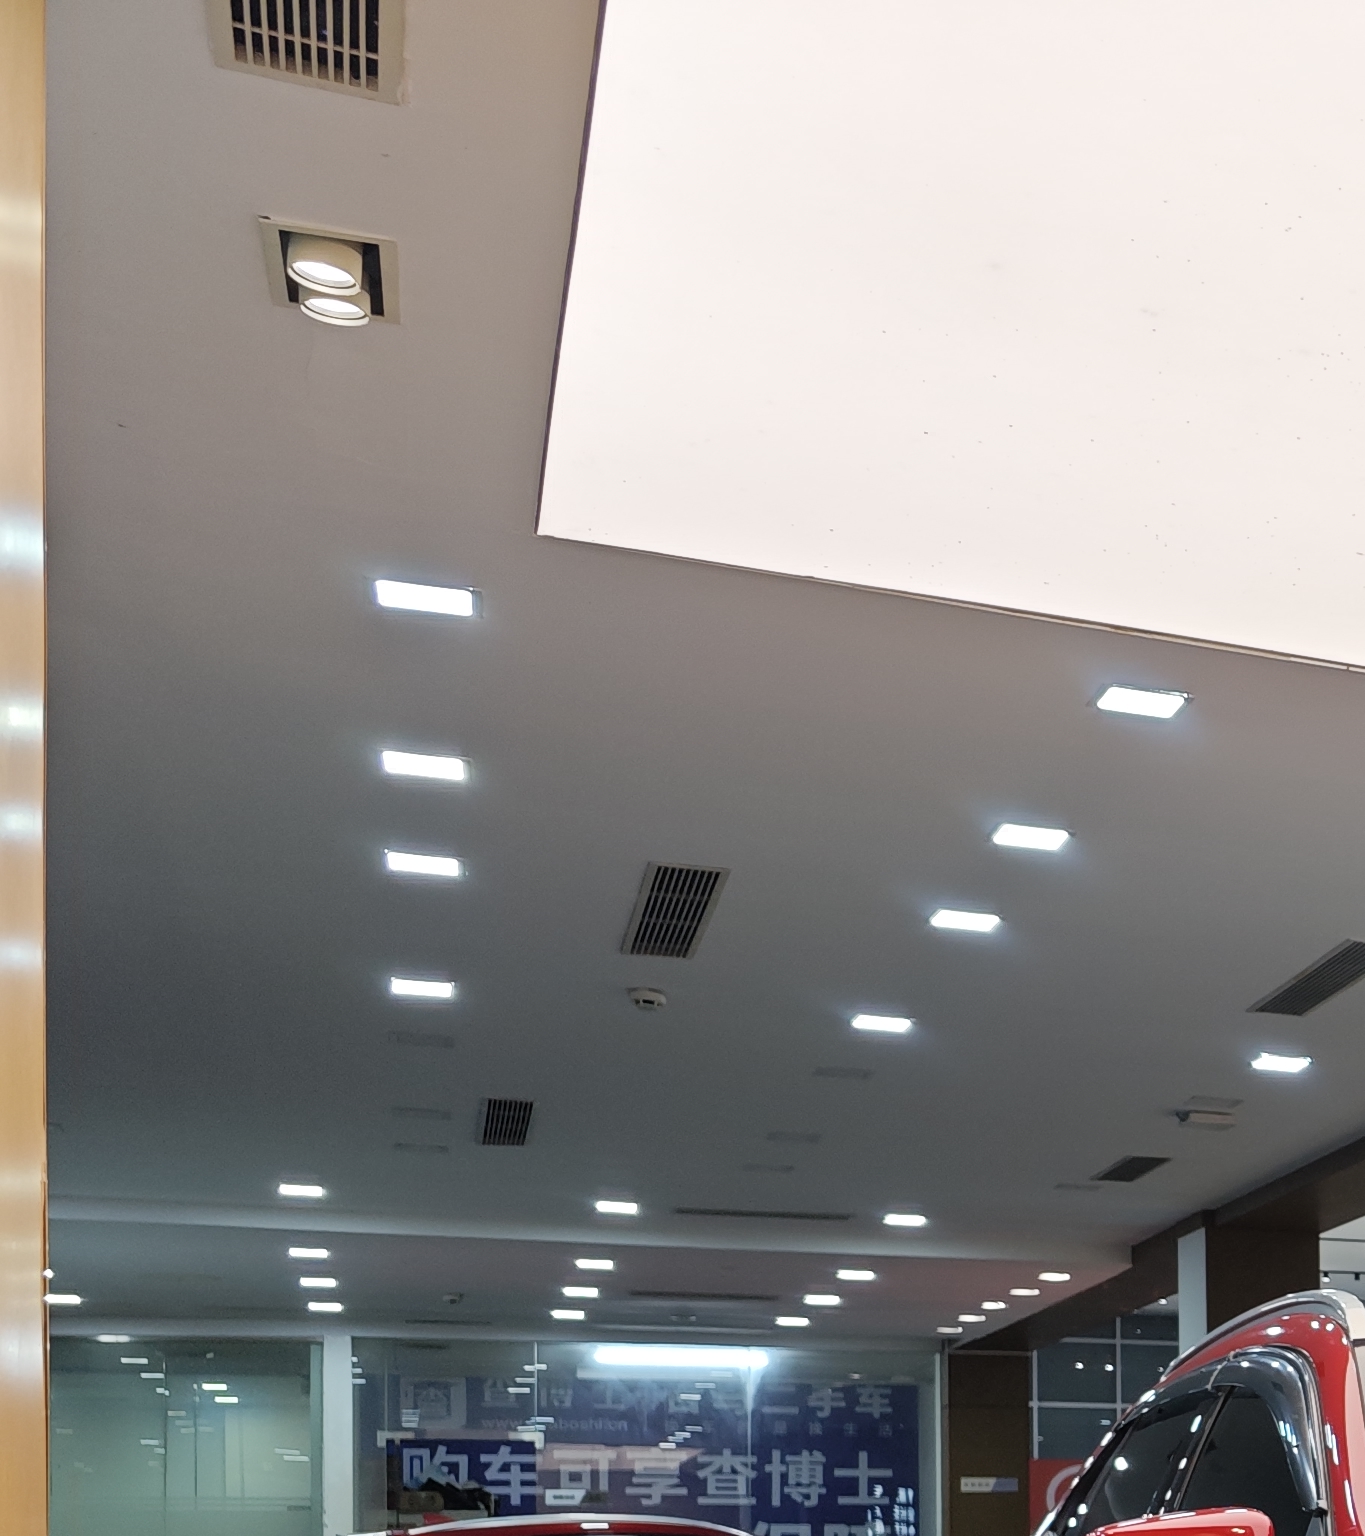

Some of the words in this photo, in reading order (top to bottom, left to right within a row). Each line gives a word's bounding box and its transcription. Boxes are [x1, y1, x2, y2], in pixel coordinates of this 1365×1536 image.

[402, 1445, 893, 1507] 购车可享查博士
